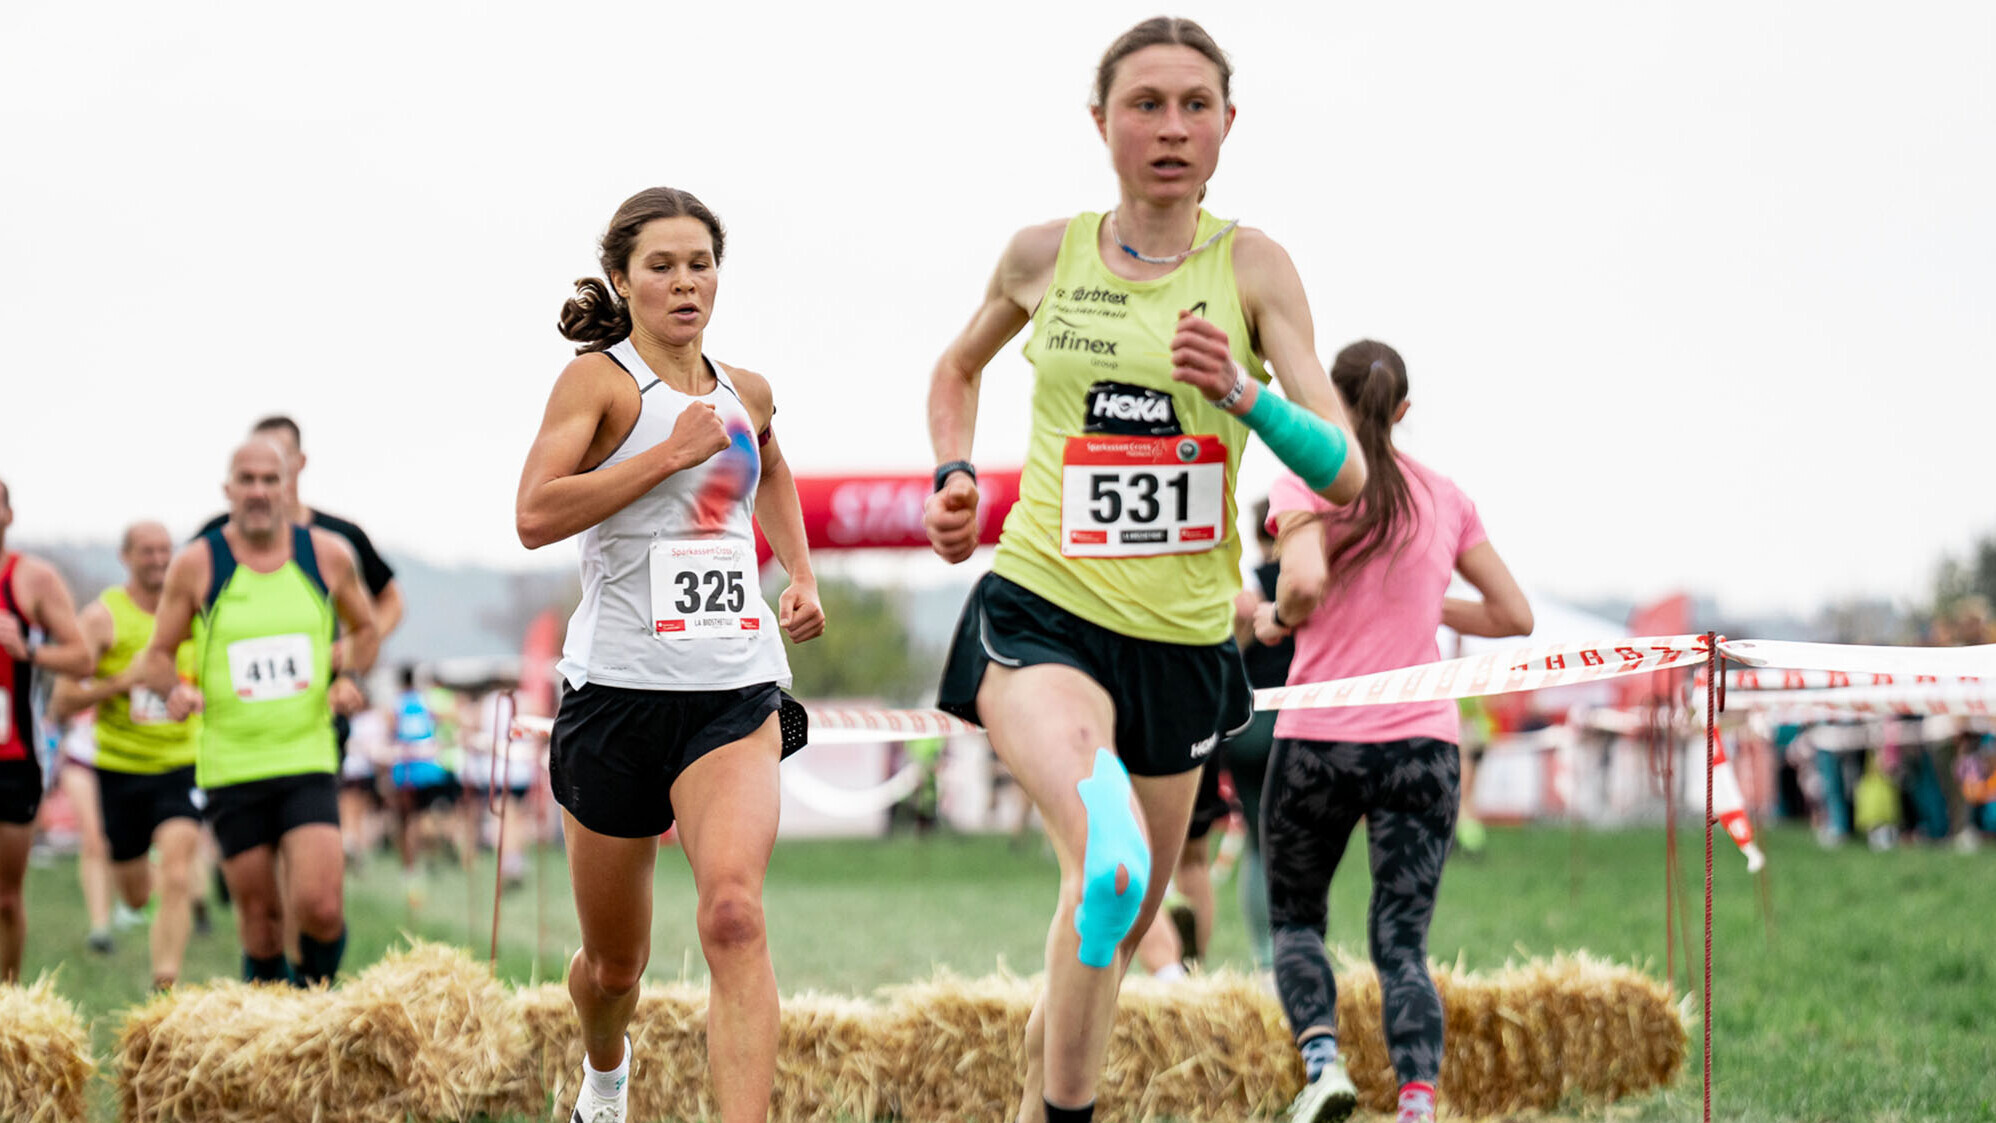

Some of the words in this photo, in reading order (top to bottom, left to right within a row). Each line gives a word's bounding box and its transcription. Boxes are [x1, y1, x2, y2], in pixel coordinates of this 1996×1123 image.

[1046, 330, 1118, 356] infinex
[1093, 392, 1170, 423] HOKA
[1089, 472, 1189, 523] 531
[674, 570, 745, 614] 325
[245, 657, 296, 682] 414
